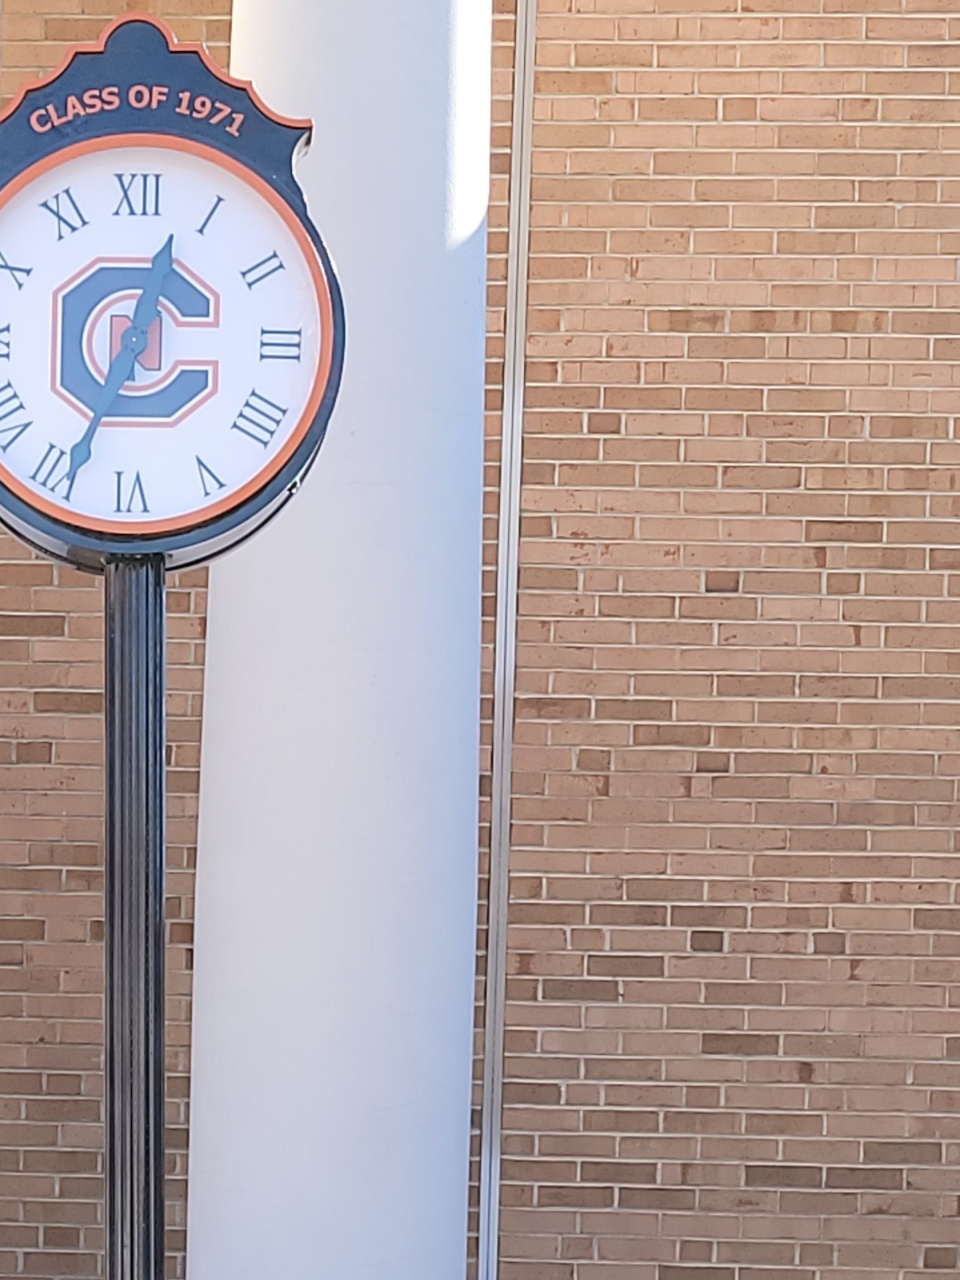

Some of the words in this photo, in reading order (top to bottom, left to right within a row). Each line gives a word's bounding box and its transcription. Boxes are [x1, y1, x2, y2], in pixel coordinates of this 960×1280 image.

[29, 86, 120, 133] CLASS
[128, 85, 169, 109] OF
[175, 91, 244, 137] 1971
[39, 187, 90, 240] XI
[112, 173, 163, 216] XII
[196, 195, 225, 235] I
[240, 250, 285, 290] II
[260, 327, 302, 362] III
[231, 388, 289, 449] IIII
[28, 442, 77, 503] VII
[114, 470, 150, 513] VI
[195, 454, 227, 498] V
